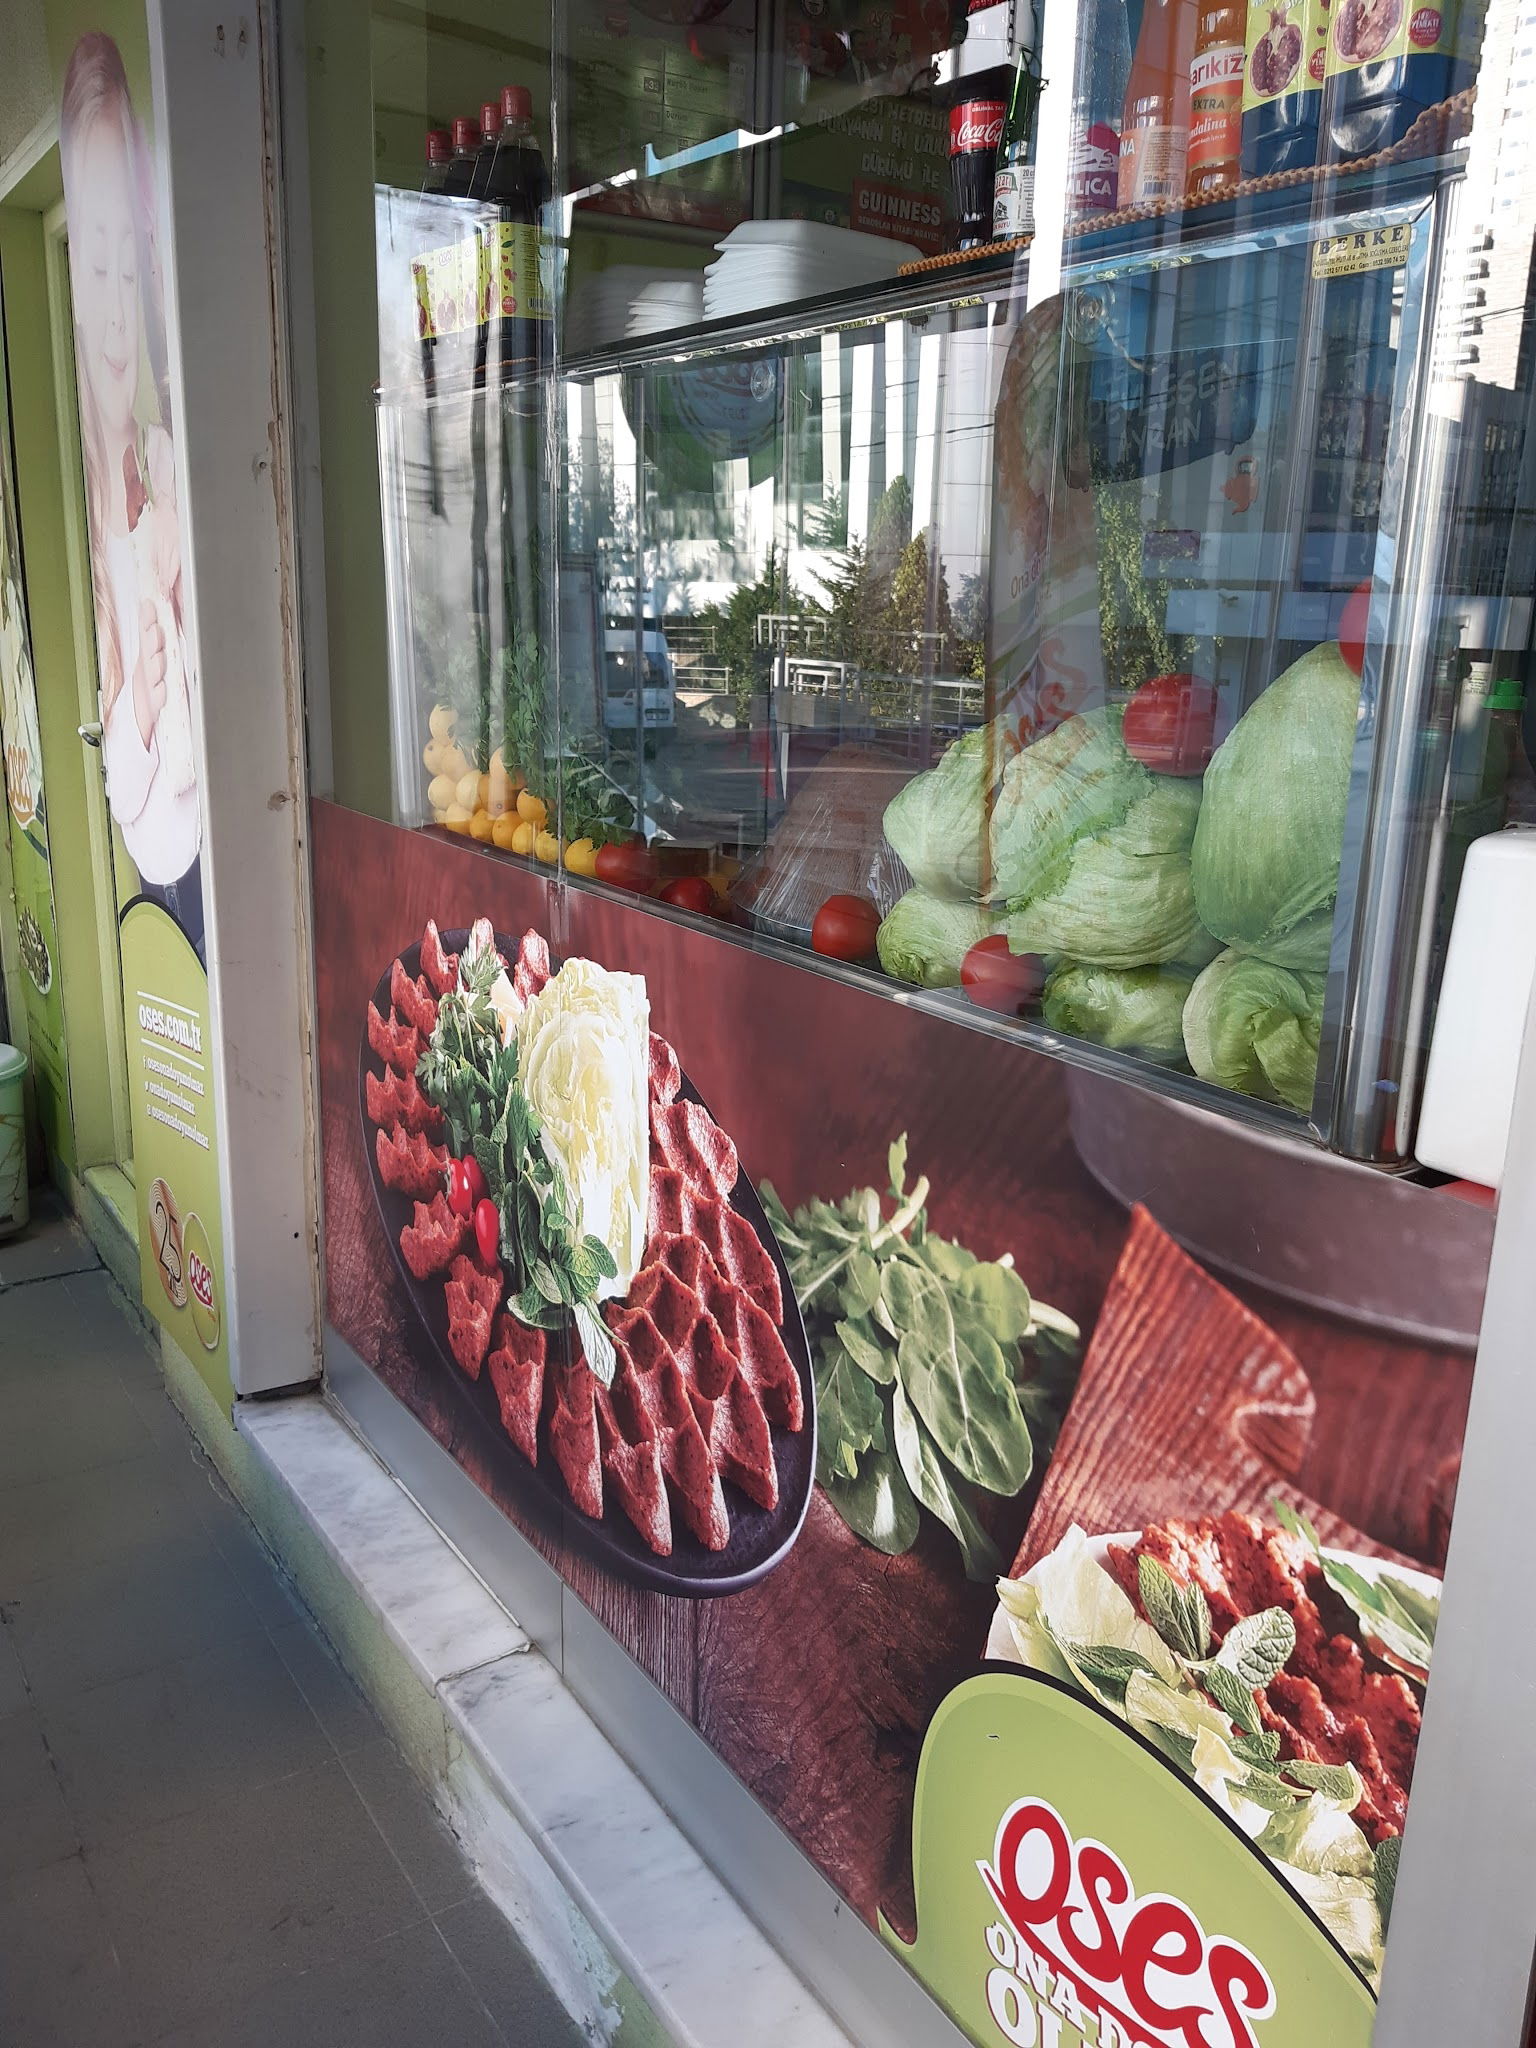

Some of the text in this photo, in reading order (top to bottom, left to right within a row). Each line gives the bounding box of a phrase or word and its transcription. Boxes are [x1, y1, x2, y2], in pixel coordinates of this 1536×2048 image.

[858, 189, 942, 226] GUINNESS
[1318, 225, 1405, 256] BERKE
[138, 1003, 202, 1055] oses.com.tr
[984, 1920, 1098, 2035] ONA
